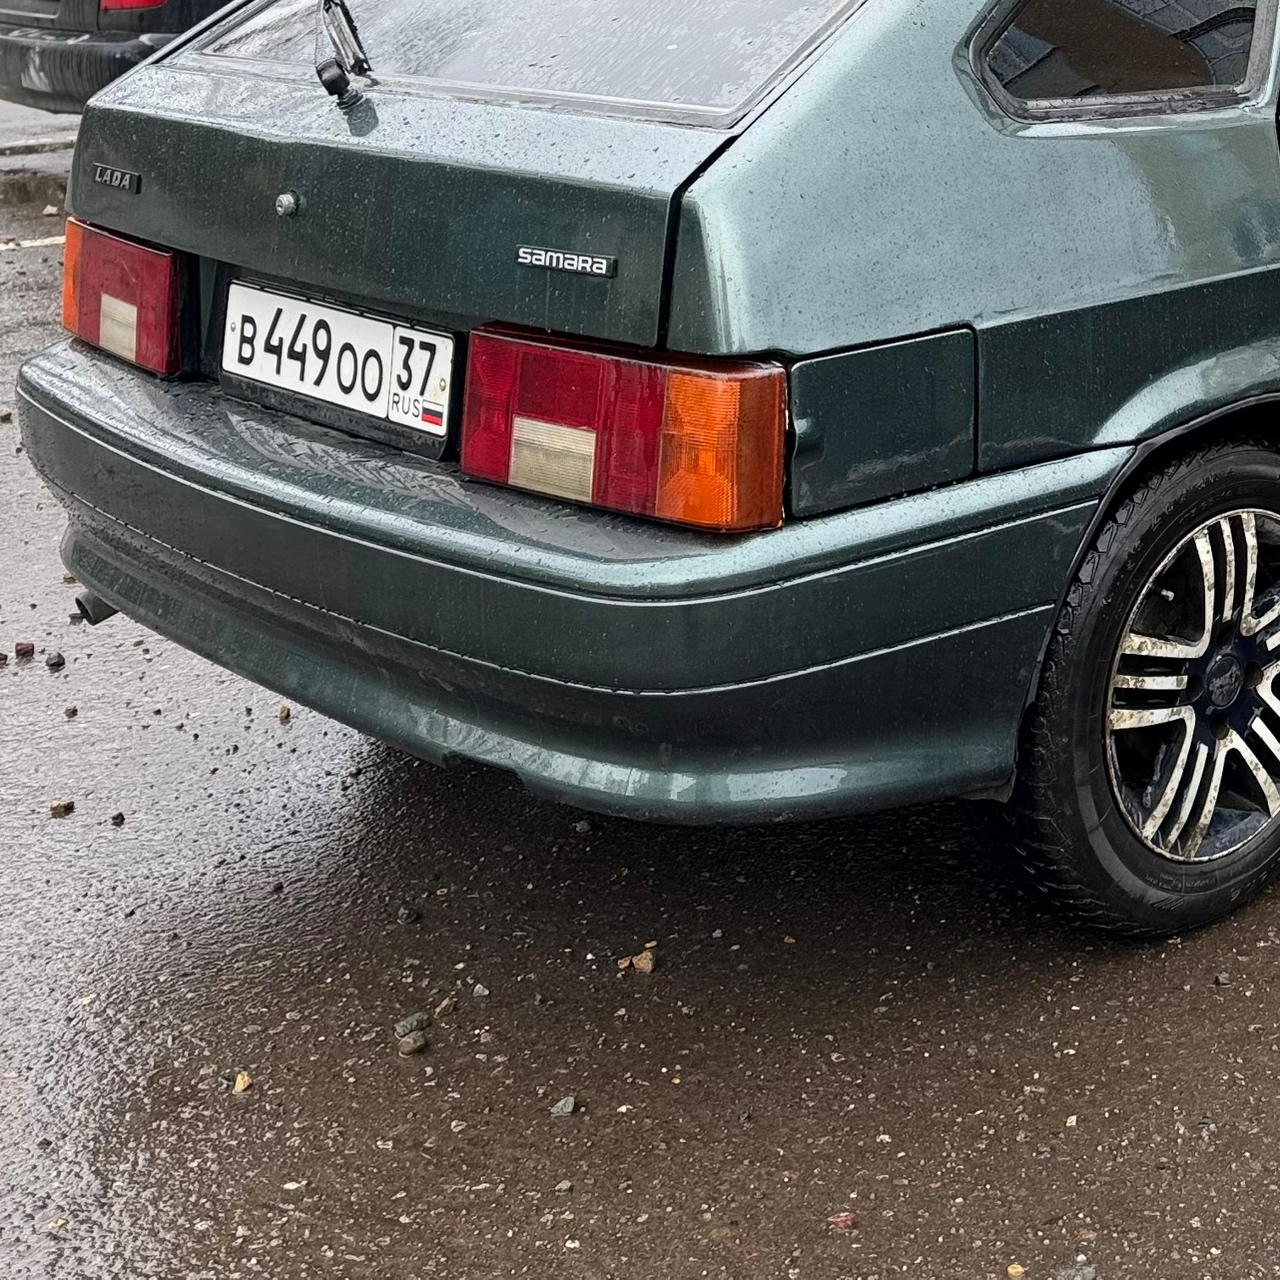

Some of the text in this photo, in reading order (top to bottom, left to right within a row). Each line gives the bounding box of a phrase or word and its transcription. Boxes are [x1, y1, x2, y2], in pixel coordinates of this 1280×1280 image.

[94, 167, 131, 189] LADA
[396, 335, 437, 397] 37
[391, 393, 421, 418] RUS
